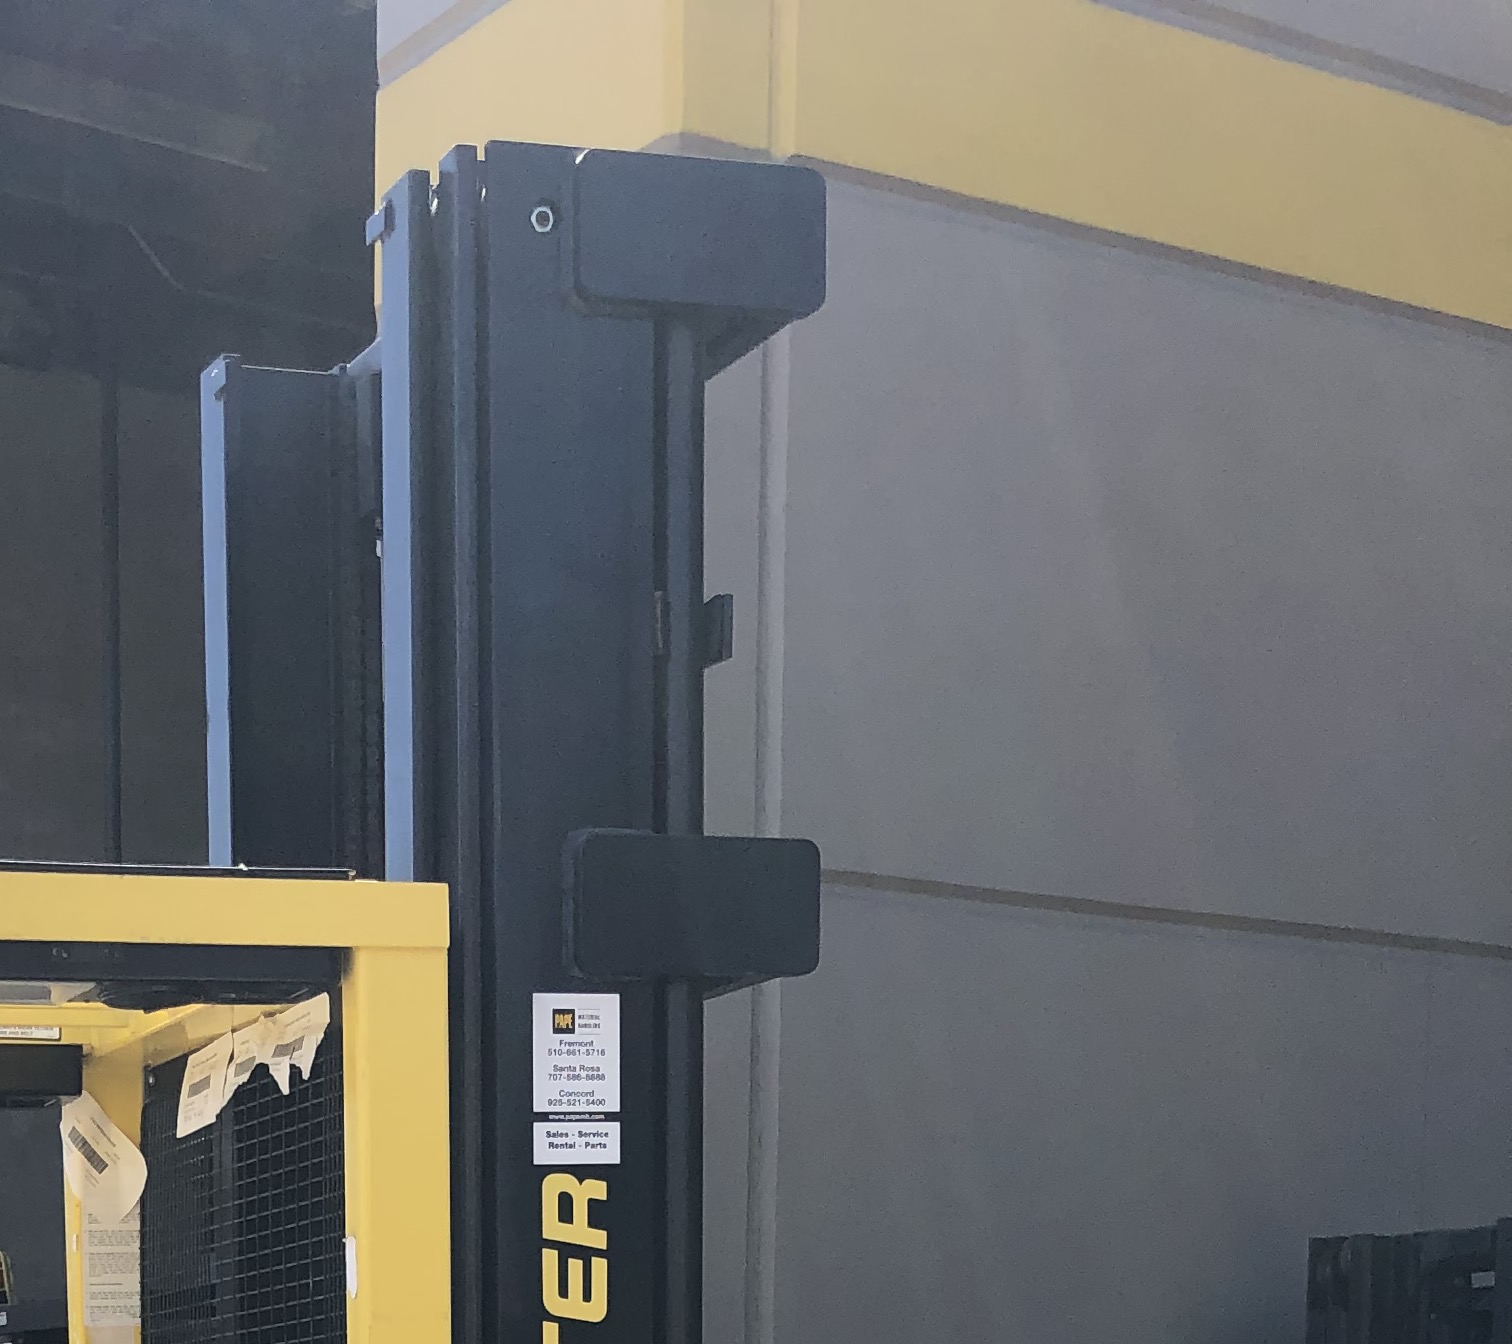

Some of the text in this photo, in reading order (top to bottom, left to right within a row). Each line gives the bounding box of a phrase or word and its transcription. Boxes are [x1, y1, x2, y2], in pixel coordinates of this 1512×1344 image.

[559, 1039, 594, 1047] Fremont
[552, 1064, 601, 1072] Santa Rosa
[558, 1089, 595, 1097] Concord
[545, 1130, 569, 1138] Sales
[577, 1130, 609, 1138] Service
[548, 1141, 576, 1149] Rental
[584, 1141, 607, 1149] Parts
